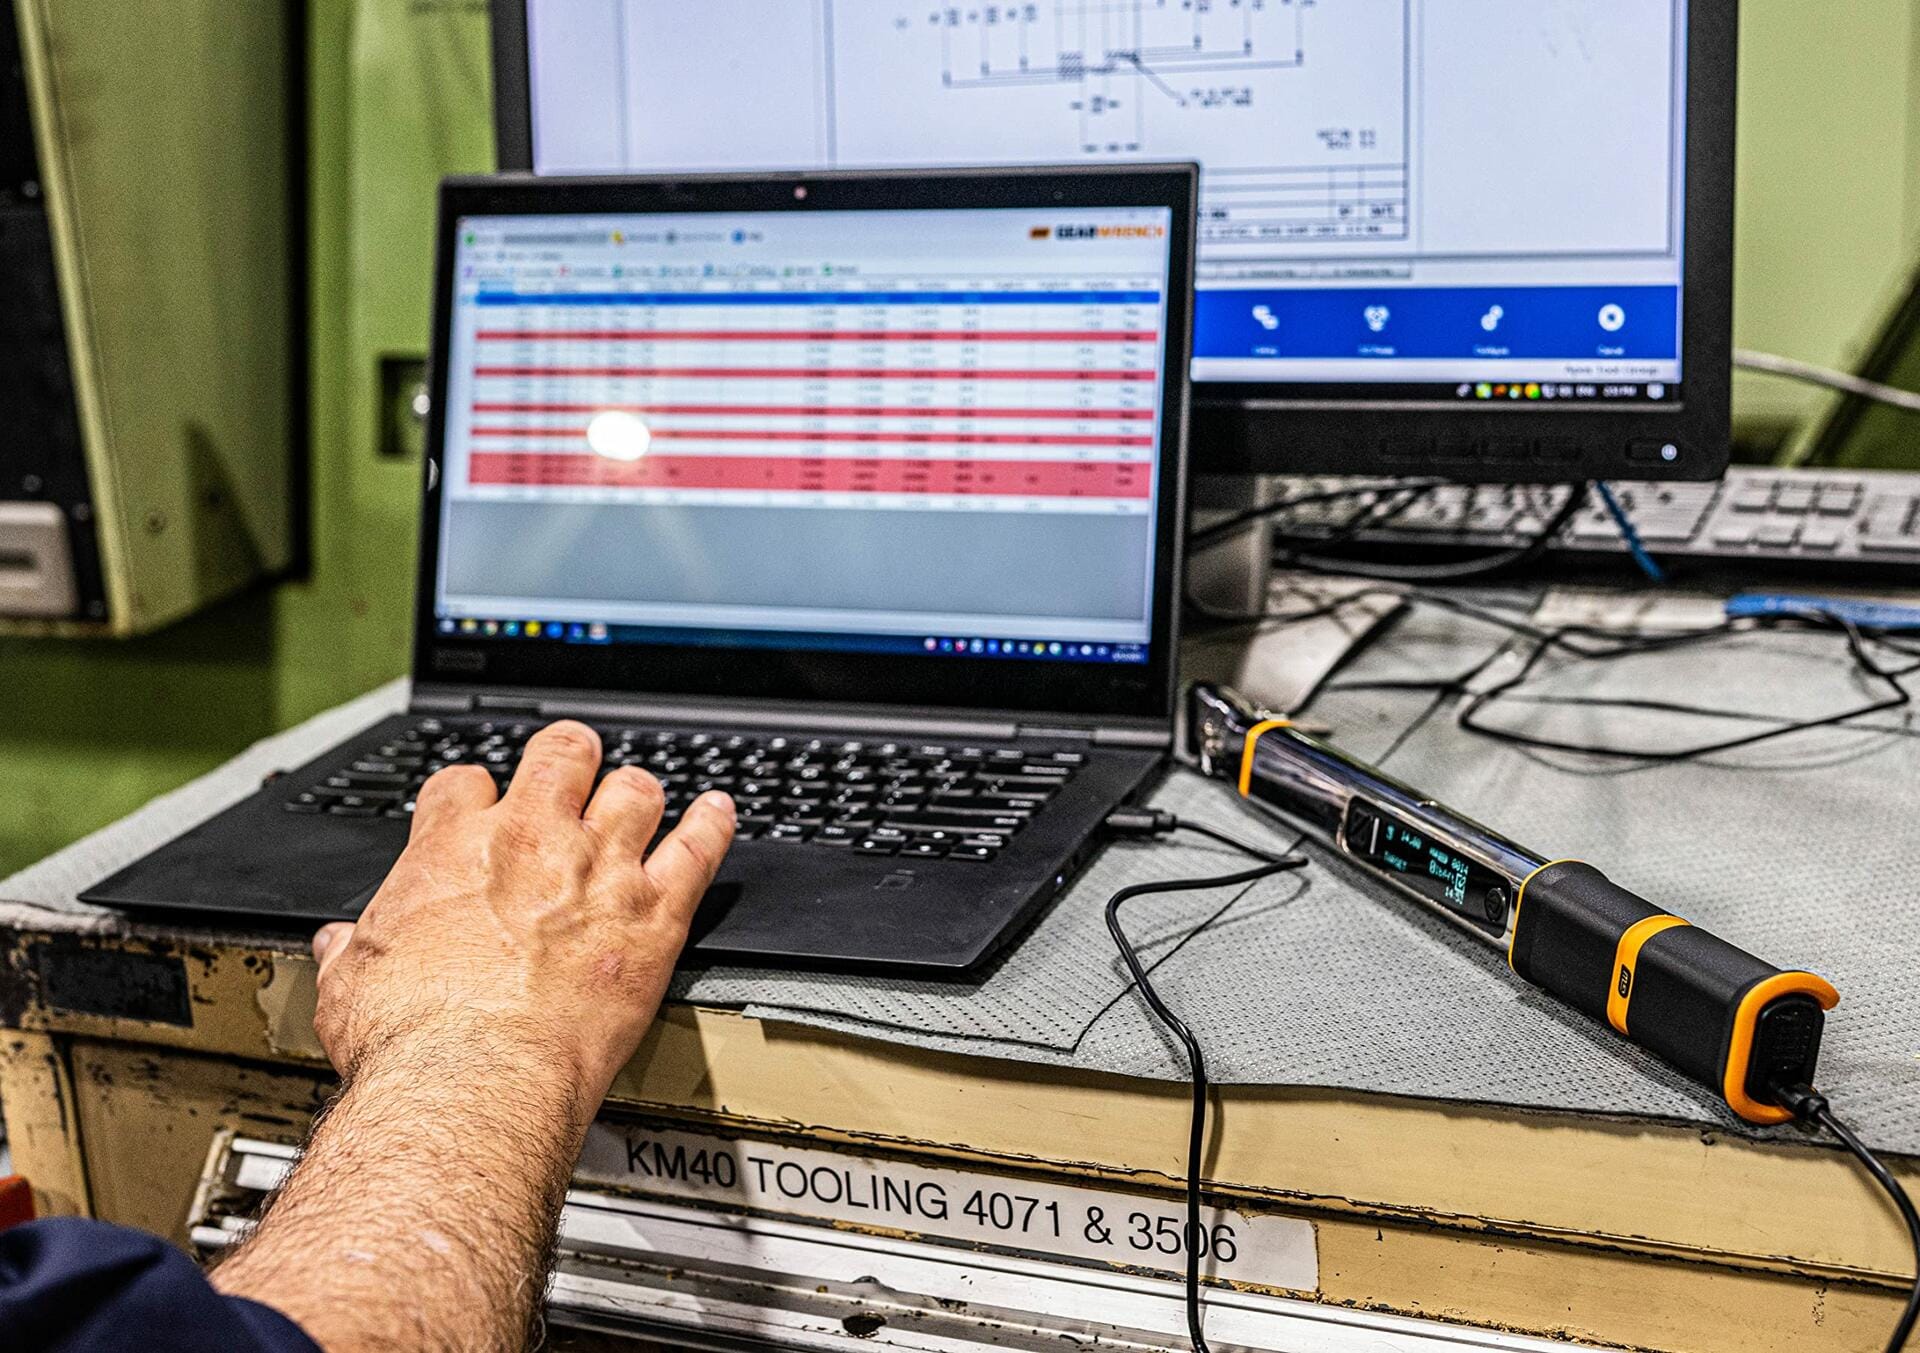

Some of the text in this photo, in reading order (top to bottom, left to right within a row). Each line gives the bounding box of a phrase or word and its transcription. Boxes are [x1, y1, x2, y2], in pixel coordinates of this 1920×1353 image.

[625, 1138, 1238, 1263] KM40 TOOLING 4071 & 3506
